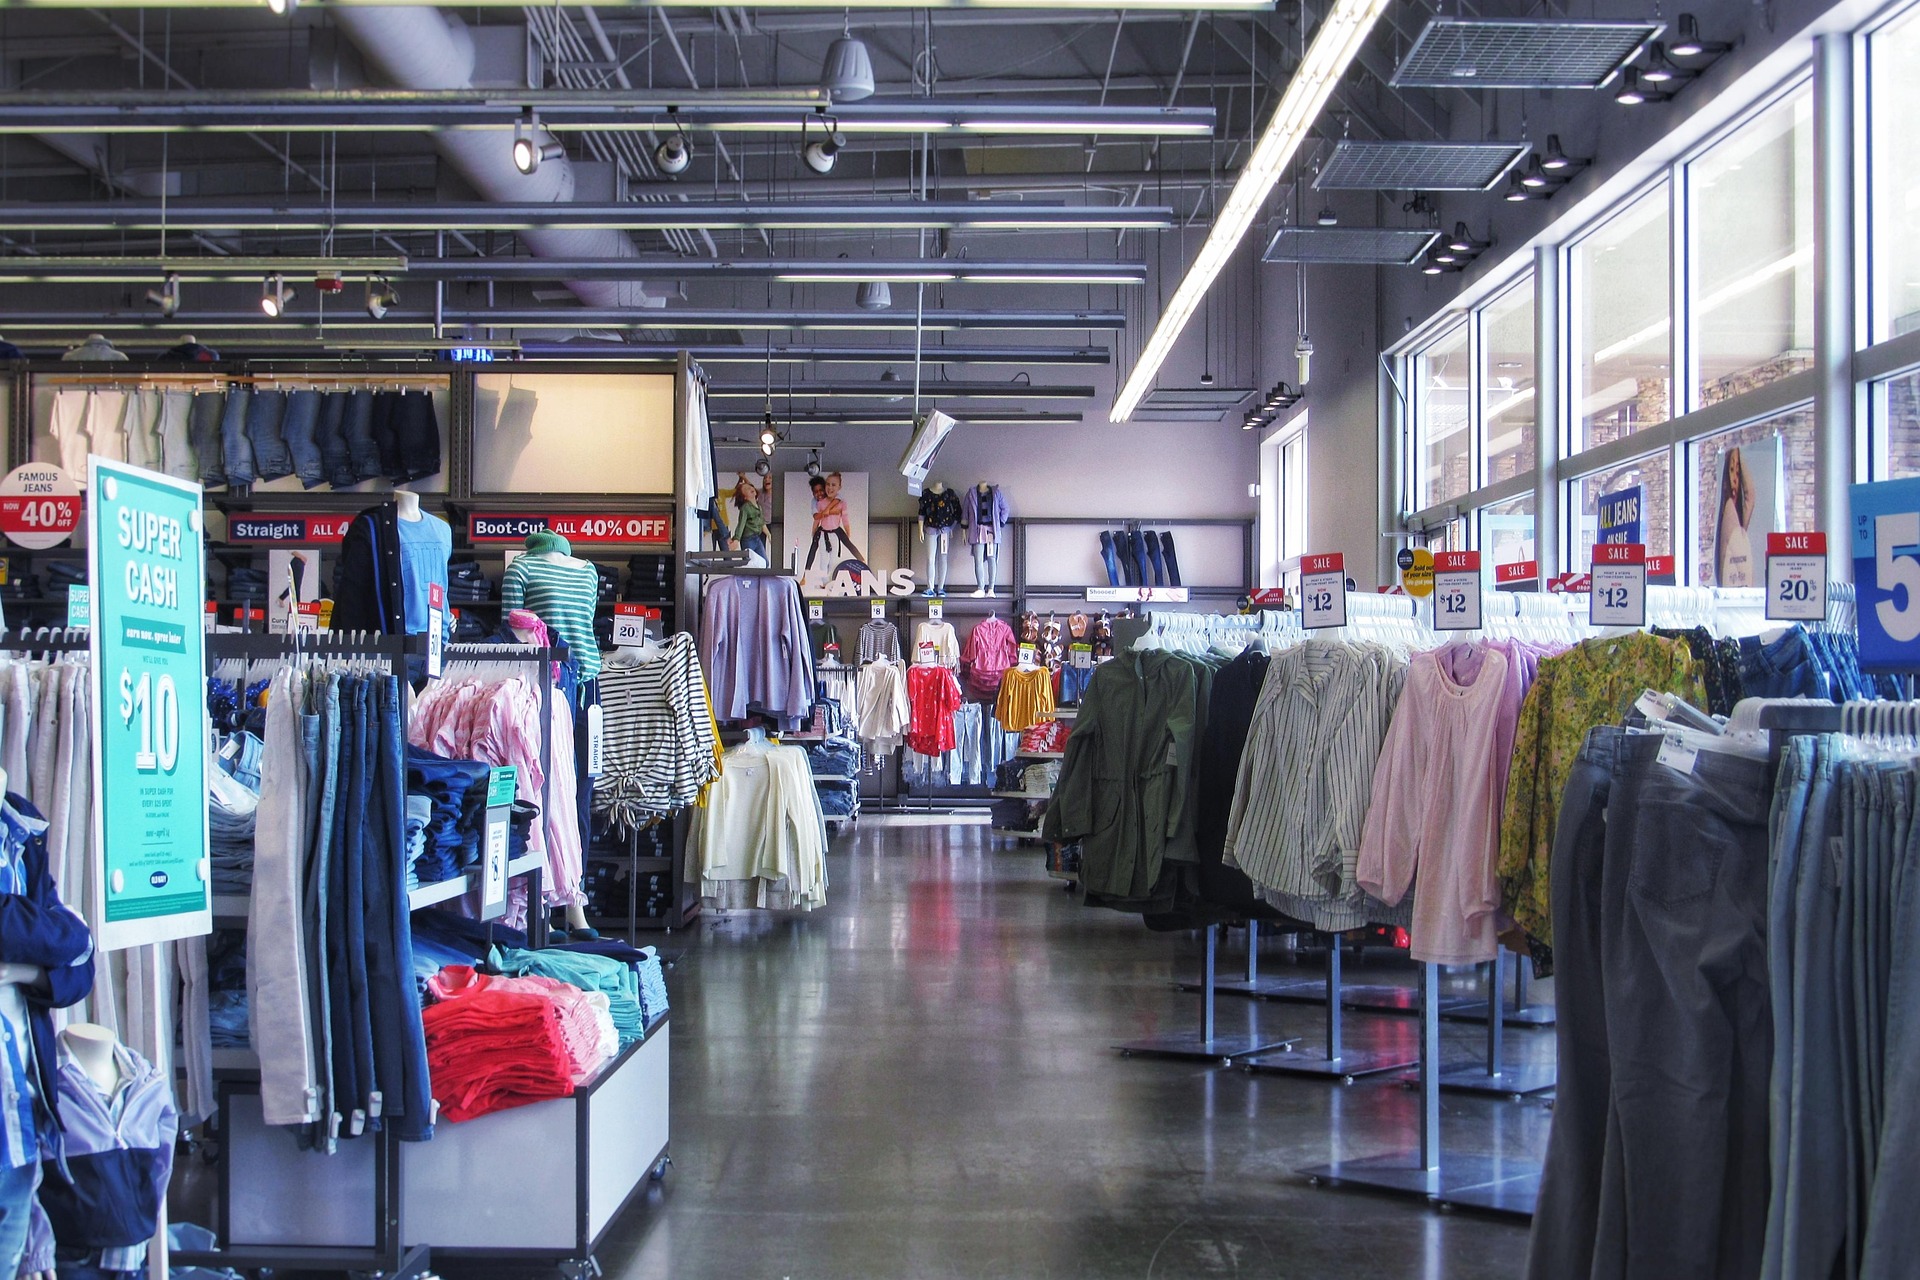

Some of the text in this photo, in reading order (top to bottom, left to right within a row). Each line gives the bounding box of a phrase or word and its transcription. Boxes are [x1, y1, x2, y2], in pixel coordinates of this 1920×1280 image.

[18, 472, 58, 482] FAMOUS
[23, 483, 53, 493] JEANS
[3, 502, 20, 511] NOW
[1600, 497, 1638, 529] ALL JEANS
[57, 518, 73, 527] OFF
[1858, 515, 1868, 526] UP
[118, 506, 182, 560] SUPER
[236, 523, 299, 540] Straight
[313, 524, 334, 536] ALL
[475, 519, 666, 537] Boot-Cut ALL 40% OFF
[1859, 529, 1868, 540] TO
[1785, 536, 1809, 549] SALE
[1608, 547, 1629, 560] SALE
[1313, 557, 1330, 569] SALE
[1447, 555, 1466, 567] SALE
[1508, 565, 1525, 577] SALE
[125, 560, 178, 610] CASH
[802, 567, 916, 597] EANS
[1307, 592, 1333, 612] $12
[1440, 594, 1467, 613] $12
[1598, 587, 1628, 608] $12
[298, 603, 311, 612] SALE
[624, 605, 637, 614] SALE
[119, 666, 179, 776] $10
[144, 787, 157, 796] SUPER
